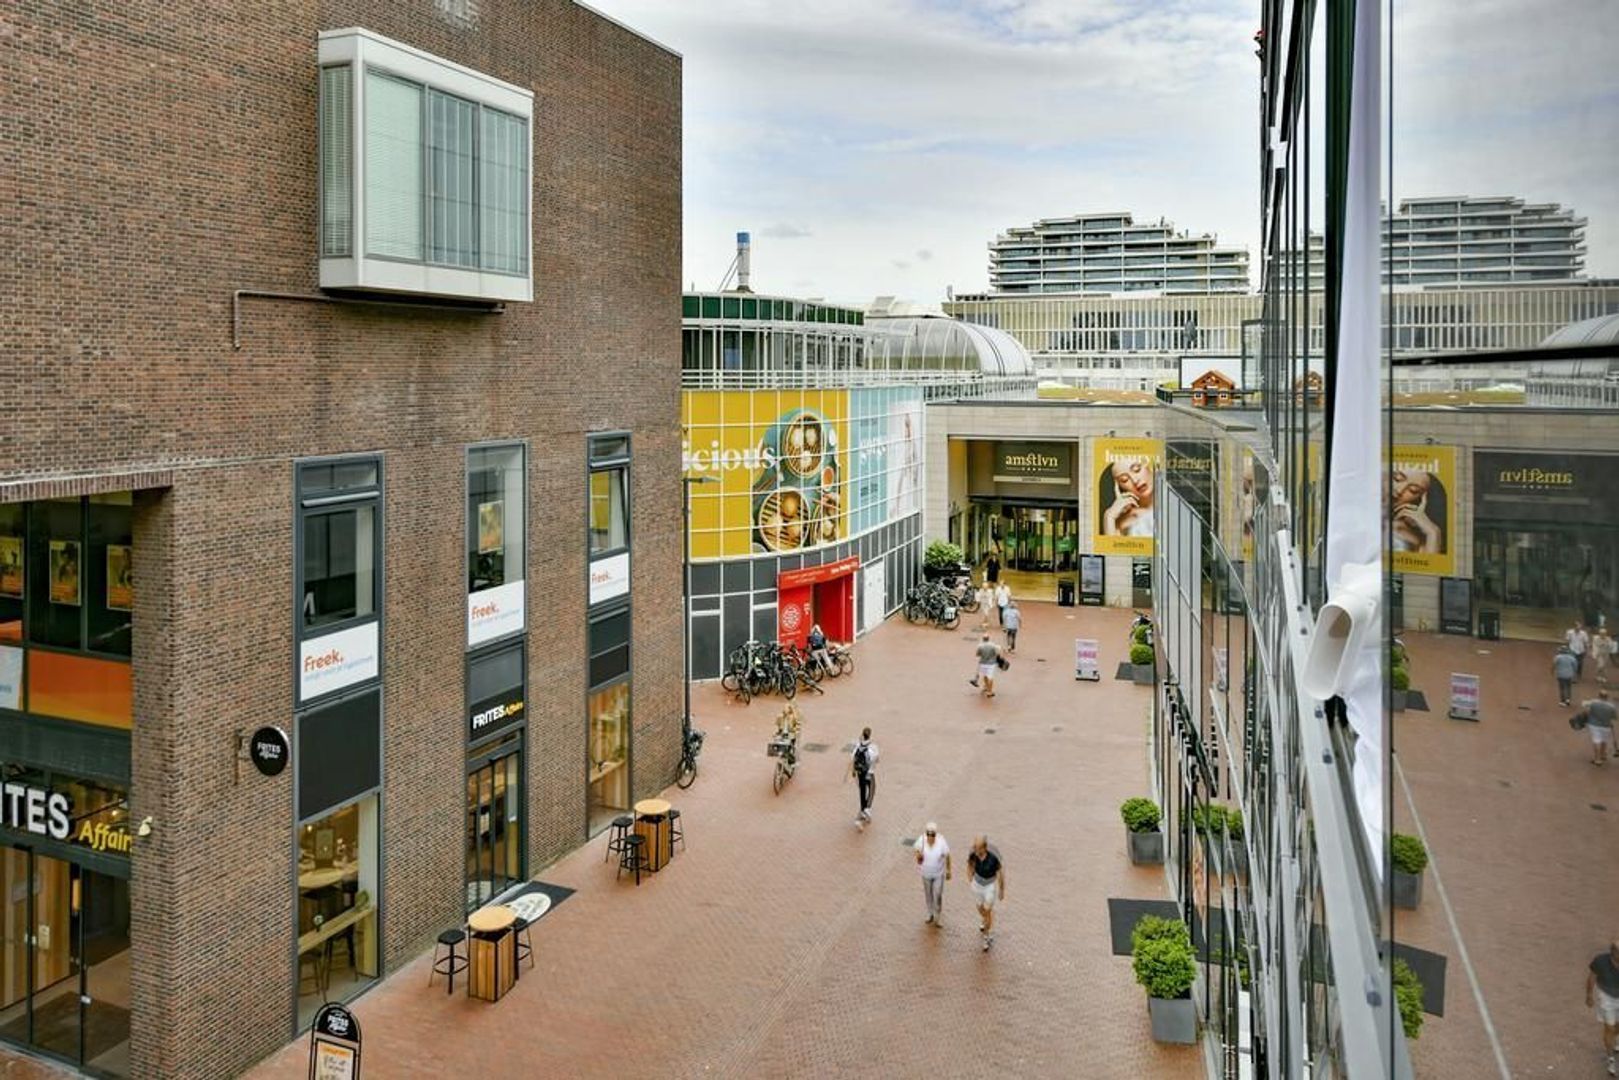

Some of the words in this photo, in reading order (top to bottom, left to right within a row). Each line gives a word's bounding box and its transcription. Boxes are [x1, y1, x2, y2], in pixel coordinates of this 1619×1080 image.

[304, 648, 344, 672] Freek.
[473, 704, 505, 730] FRITES
[79, 820, 132, 853] Affair
